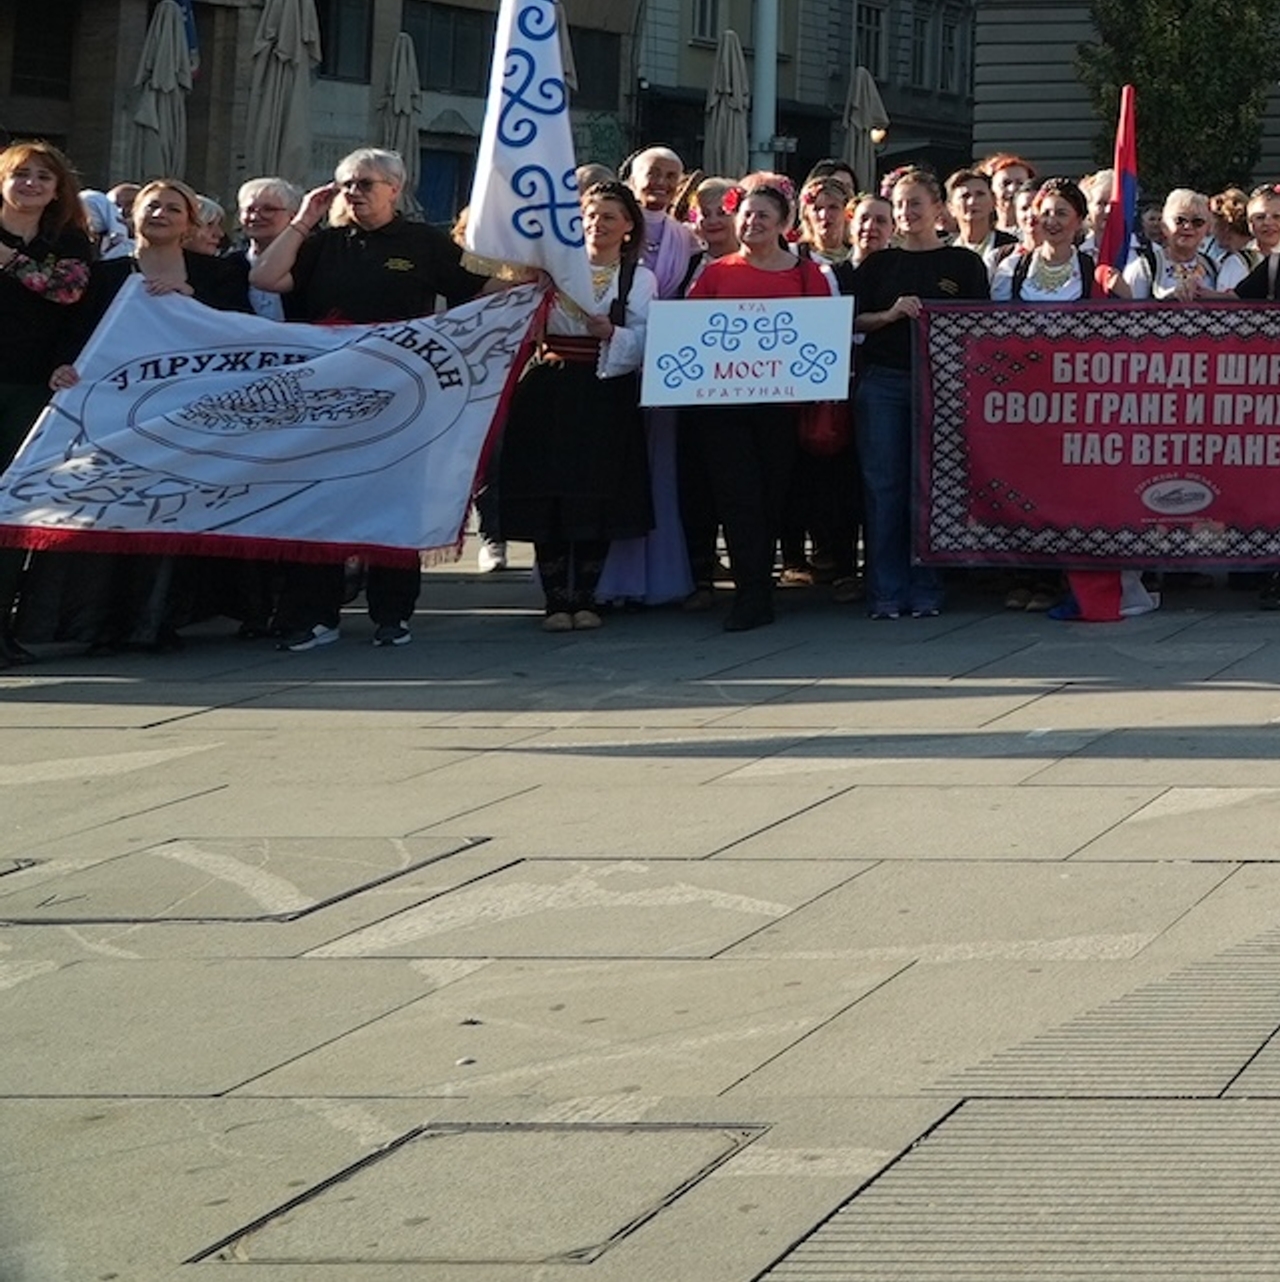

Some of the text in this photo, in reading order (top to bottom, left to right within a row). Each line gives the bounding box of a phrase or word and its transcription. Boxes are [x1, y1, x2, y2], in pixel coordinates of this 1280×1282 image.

[738, 302, 767, 313] КУД
[713, 359, 783, 380] МОСТ
[1052, 351, 1208, 389] БЕОГРАДЕ
[696, 386, 796, 398] БРАТУНАЦ
[983, 391, 1077, 425] СВОЈЕ
[1085, 392, 1178, 426] ГРАНЕ
[1185, 393, 1206, 425] И
[1062, 433, 1124, 466] НАС
